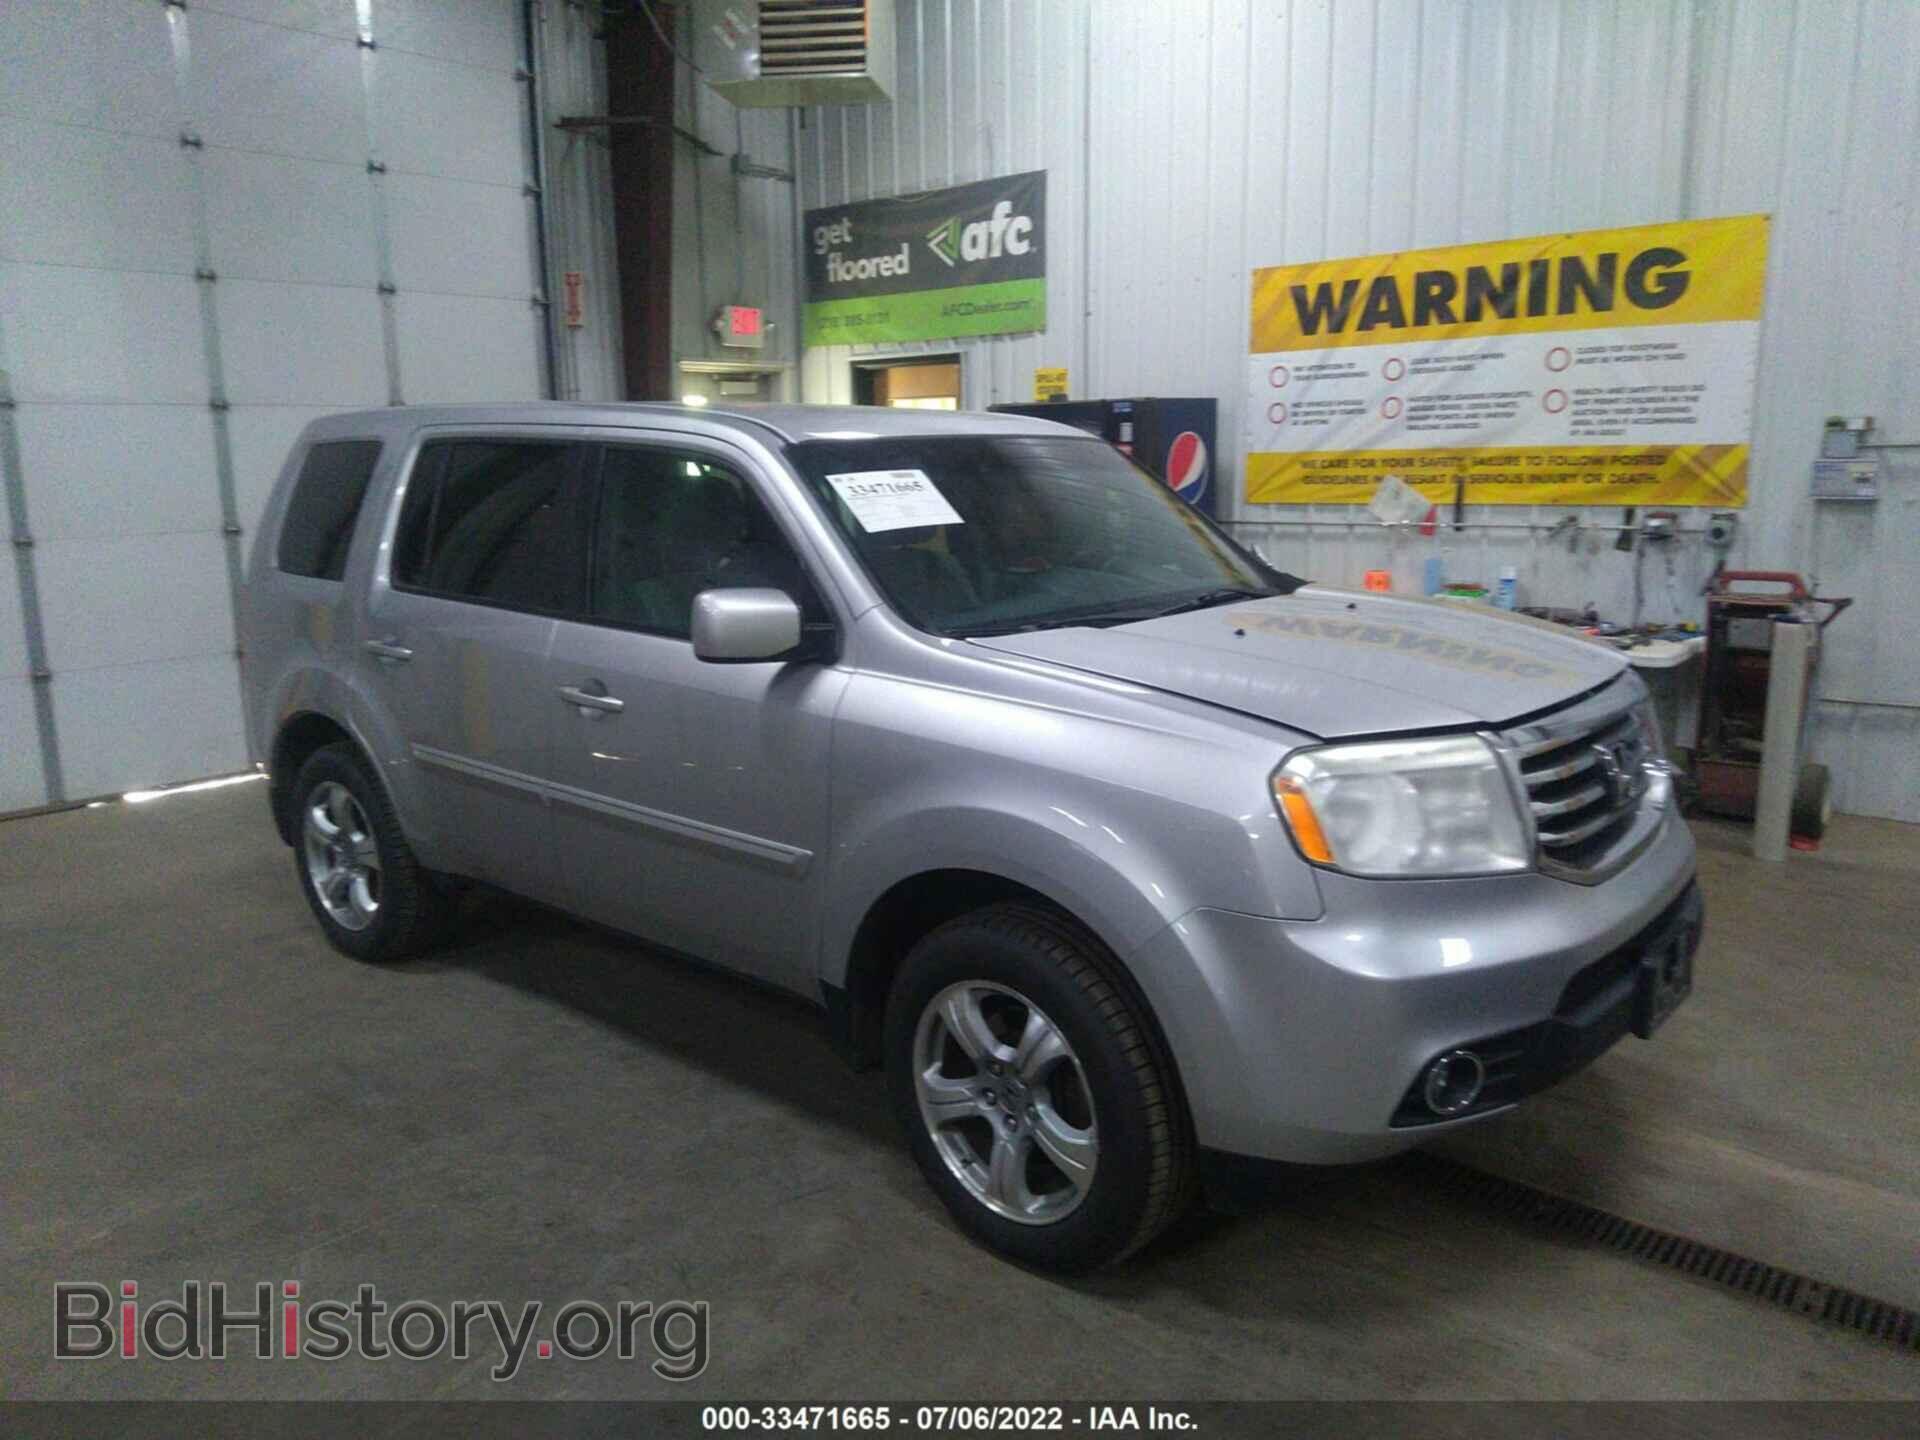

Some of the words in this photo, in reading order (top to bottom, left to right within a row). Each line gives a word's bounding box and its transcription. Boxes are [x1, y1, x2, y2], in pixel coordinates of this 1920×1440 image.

[814, 216, 853, 254] get
[961, 201, 1033, 261] afc
[826, 243, 909, 282] floored
[1289, 247, 1692, 336] WARNING
[1526, 455, 1544, 465] TO
